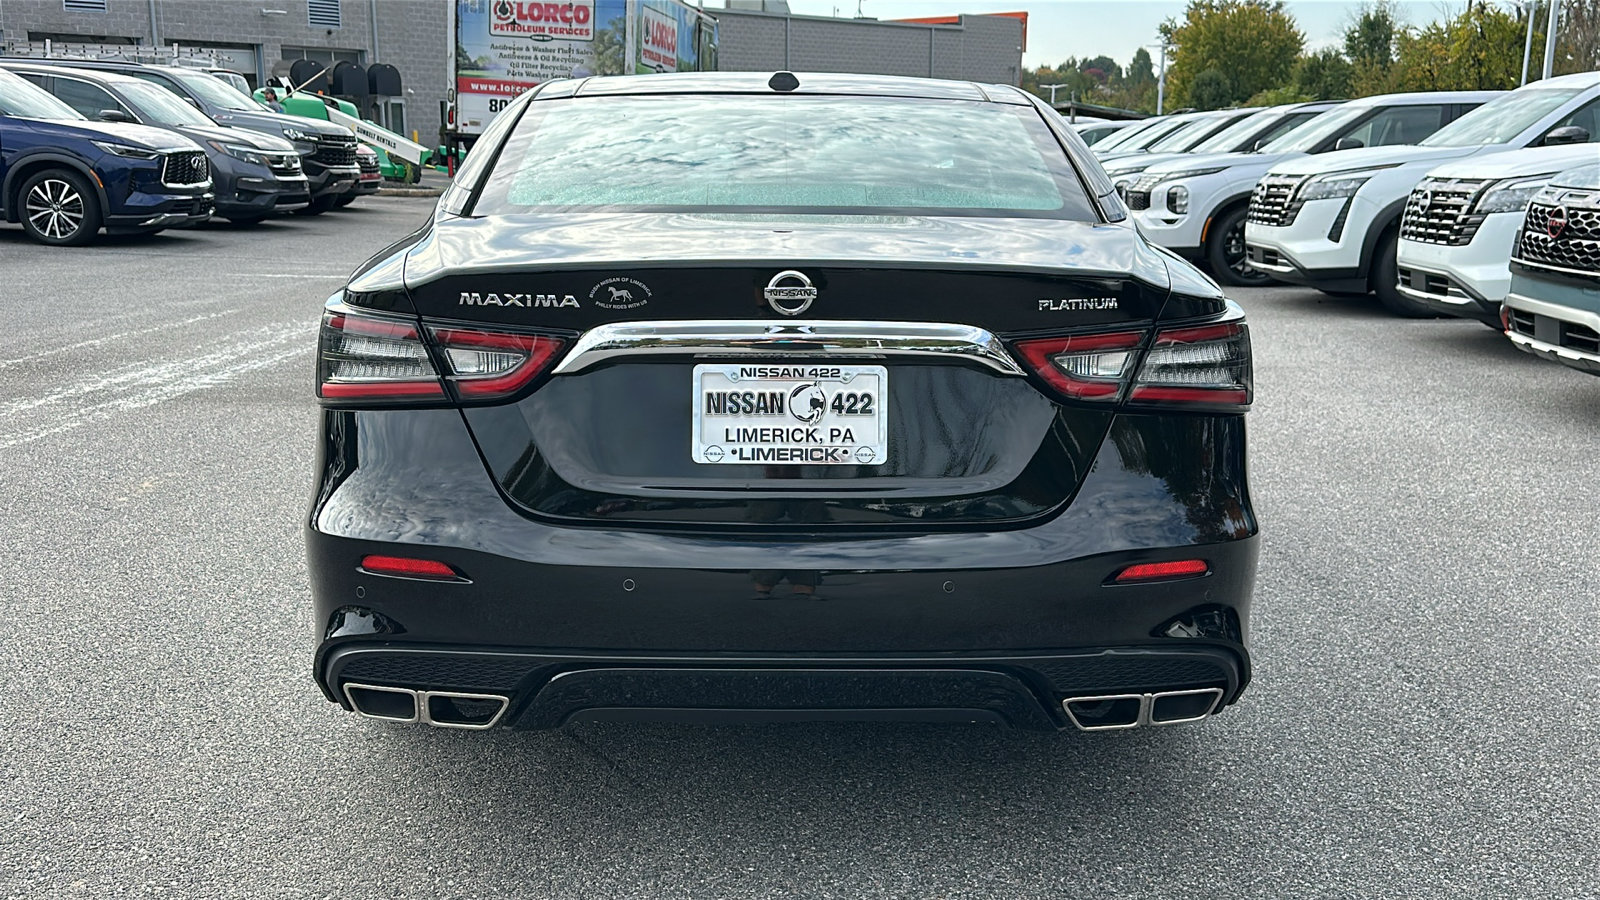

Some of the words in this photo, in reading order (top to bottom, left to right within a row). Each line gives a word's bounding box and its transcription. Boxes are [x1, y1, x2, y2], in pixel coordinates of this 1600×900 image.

[516, 2, 590, 24] LORCO
[548, 26, 590, 36] SERVICES
[490, 43, 523, 51] Antifreeze
[576, 48, 593, 56] Sales
[498, 52, 532, 61] Antifreeze
[540, 54, 550, 62] Oil
[552, 55, 584, 64] Recycling
[506, 69, 523, 77] Parts
[525, 70, 549, 78] Washer
[521, 62, 539, 70] Filter
[540, 63, 573, 72] Recycling
[357, 126, 376, 140] SUNBELT
[376, 135, 396, 149] RENTALS
[589, 283, 601, 298] BUSH
[600, 277, 621, 286] NISSAN
[630, 278, 652, 297] LIMERICK
[770, 288, 813, 297] NISSAN
[459, 292, 581, 308] MAXIMA
[595, 300, 612, 309] PHILLY
[1038, 298, 1118, 311] PLATINUM
[740, 367, 805, 378] NISSAN
[808, 368, 841, 378] 422
[706, 392, 785, 415] NISSAN
[831, 393, 873, 415] 422
[725, 428, 823, 444] LIMERICK,
[830, 428, 855, 443] PA
[739, 447, 841, 462] LIMERICK
